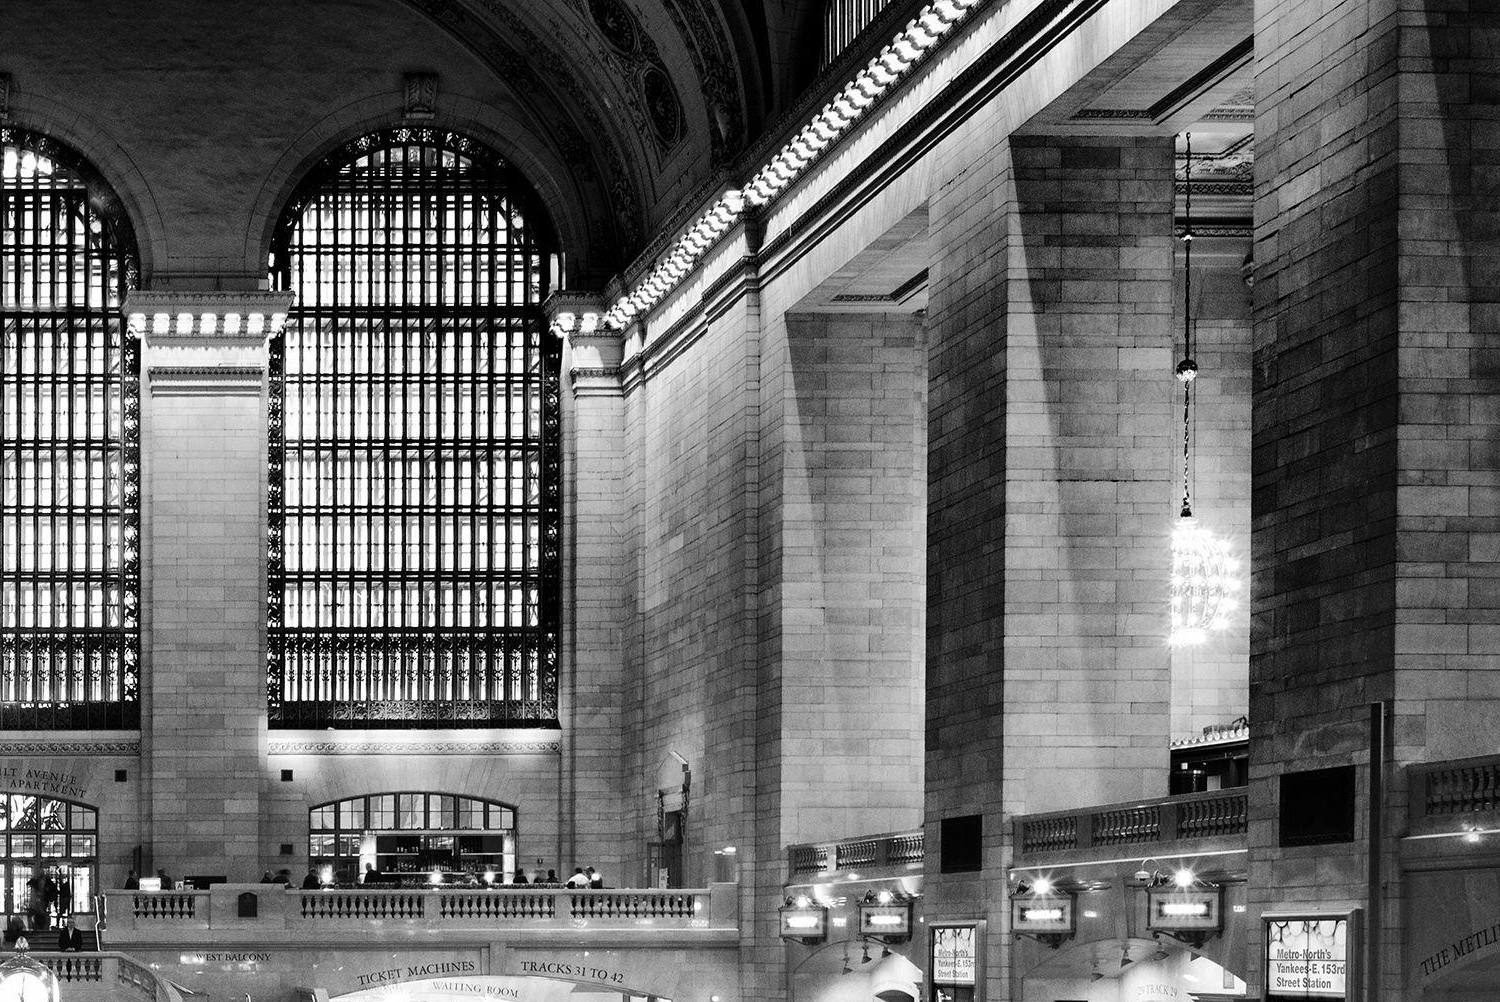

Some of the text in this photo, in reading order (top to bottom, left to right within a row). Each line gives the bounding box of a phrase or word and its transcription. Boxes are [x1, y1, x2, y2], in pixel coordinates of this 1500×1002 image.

[25, 769, 77, 785] AVENUE
[10, 778, 86, 798] APARTMENT
[196, 952, 271, 961] WEST BALCONY
[1276, 948, 1332, 960] Metro-North's
[1420, 924, 1500, 977] THE METLI
[357, 960, 475, 985] TICKET MACHINES
[521, 961, 624, 984] TRACKS 31 TO 42
[1276, 962, 1345, 975] Yankees-E. 153rd
[432, 981, 518, 999] WAITING ROOM
[1146, 983, 1169, 995] TRACK
[1276, 976, 1331, 989] Street Station
